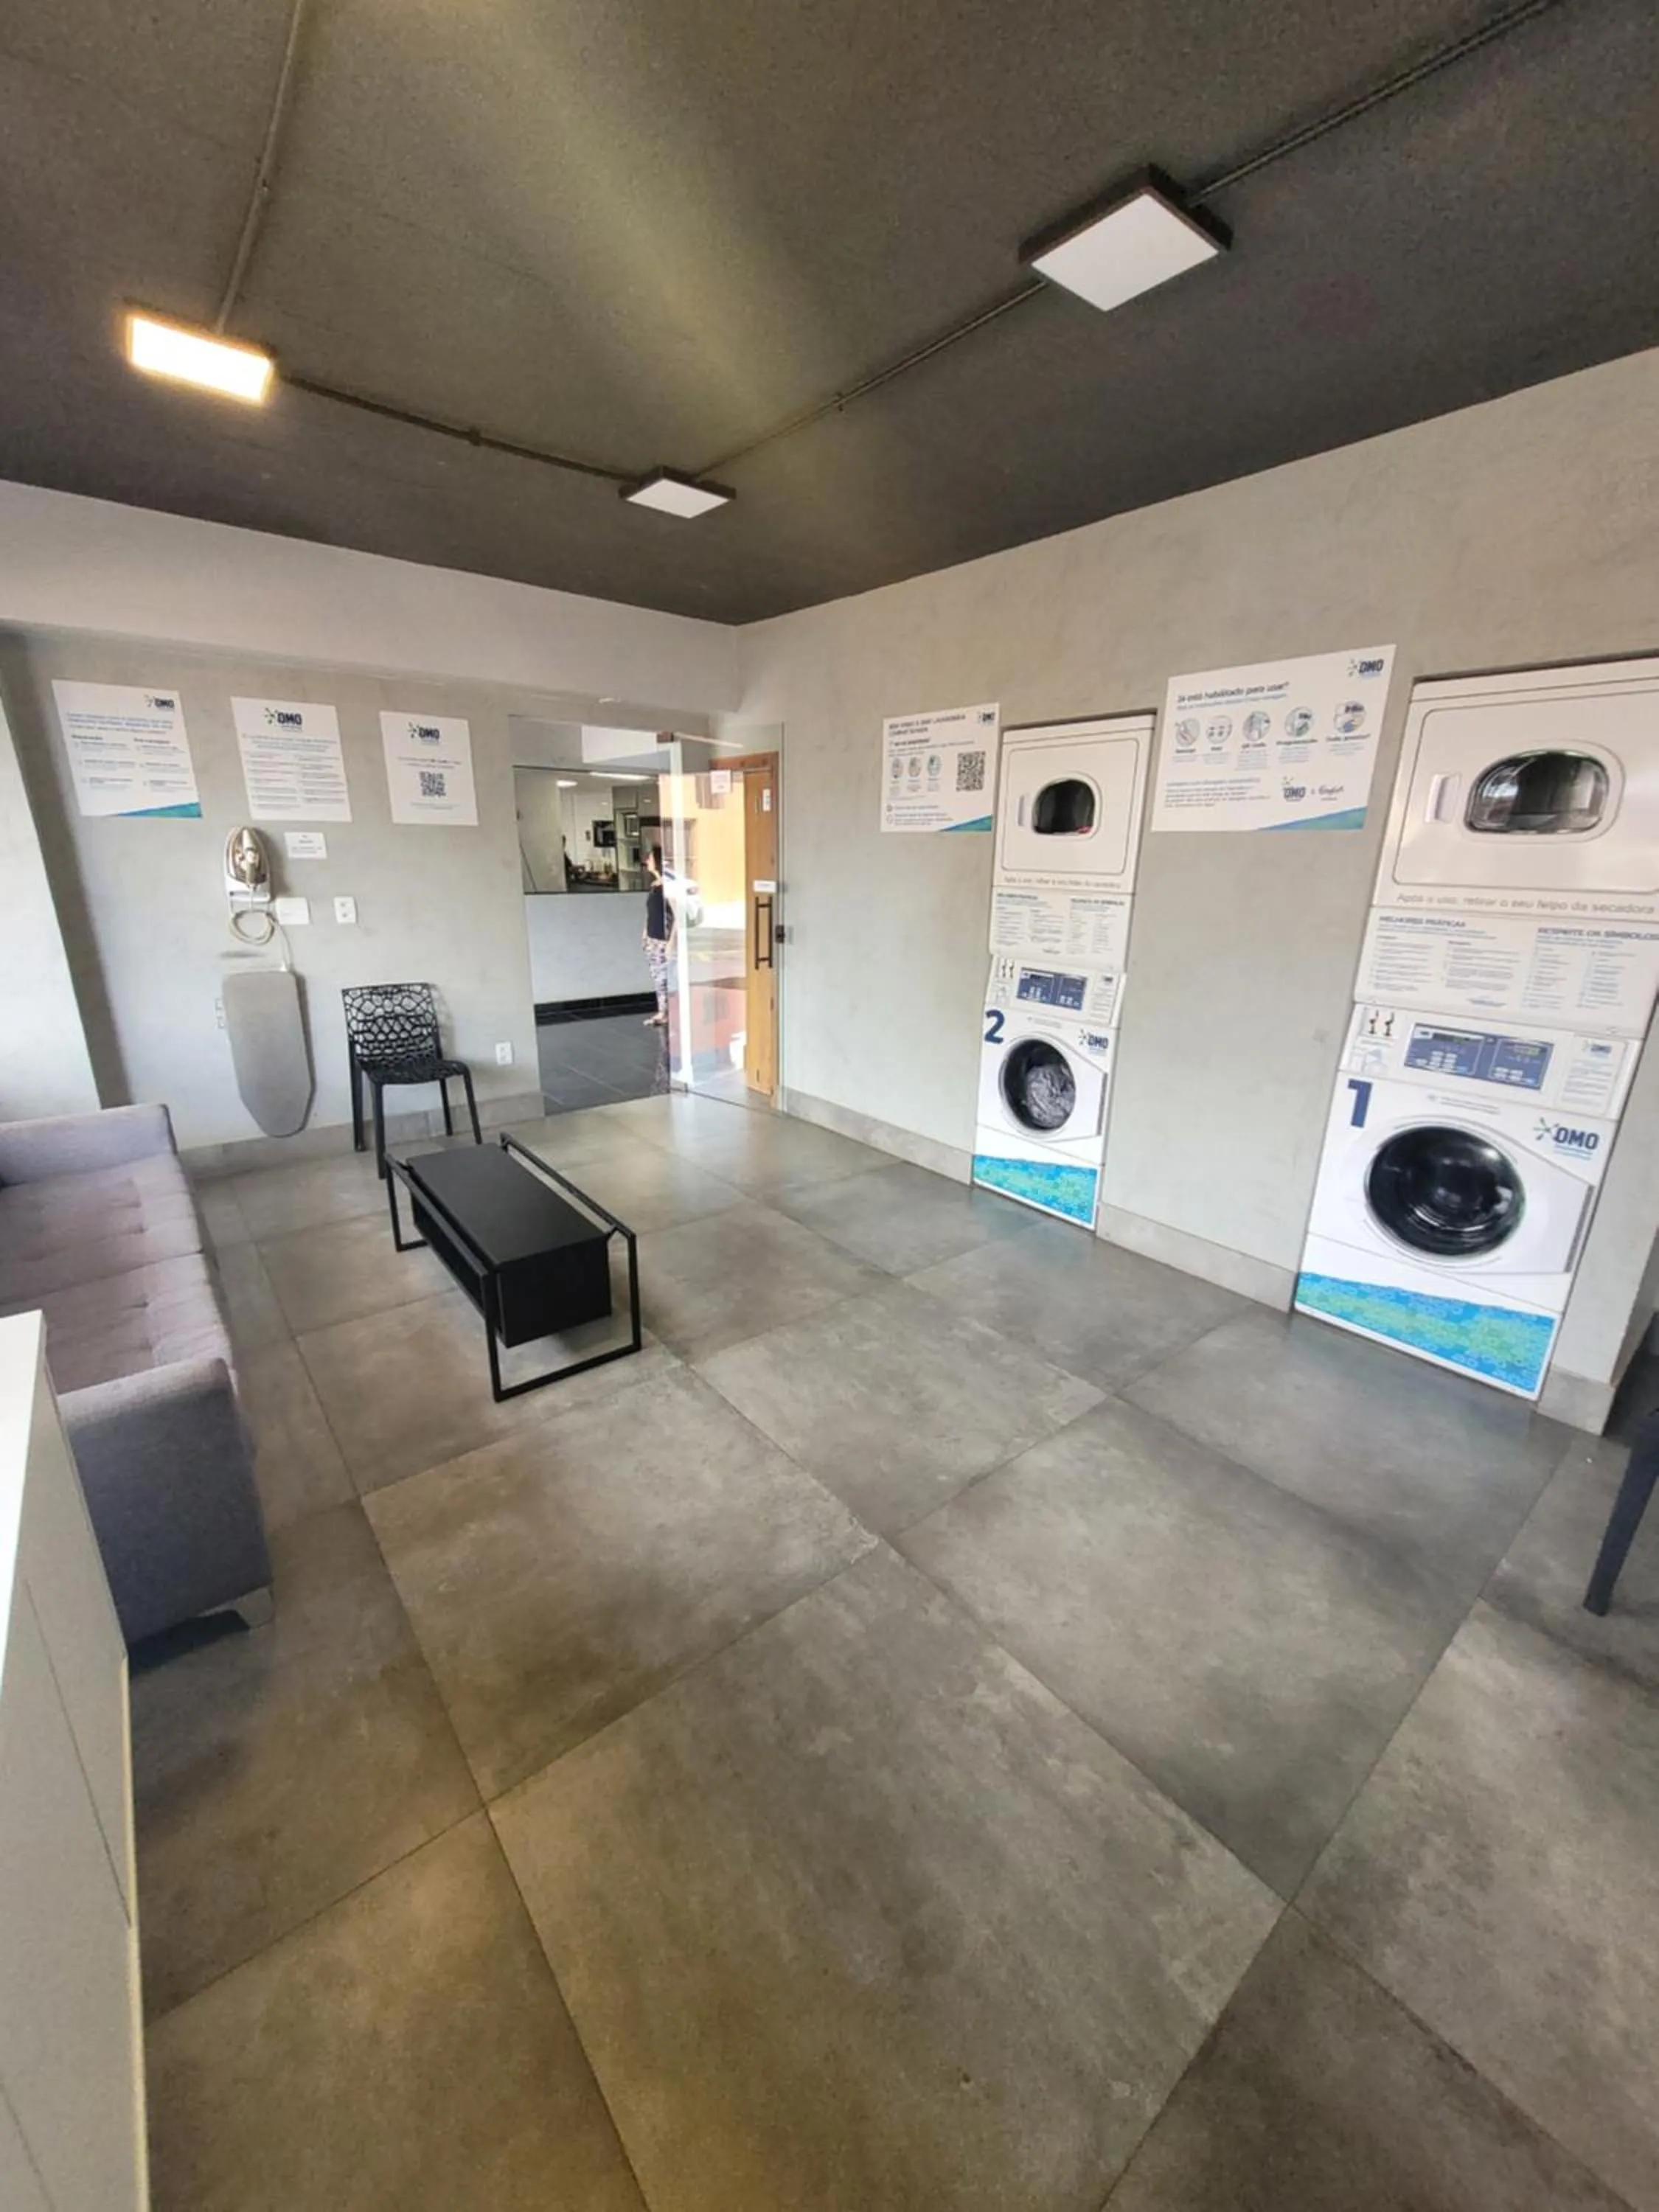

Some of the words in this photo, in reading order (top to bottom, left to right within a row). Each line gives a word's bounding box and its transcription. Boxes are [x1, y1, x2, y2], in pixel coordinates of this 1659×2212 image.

[1359, 658, 1384, 672] OMO
[1204, 687, 1245, 699] habilitado
[1245, 686, 1265, 696] para
[155, 698, 175, 709] OMO
[277, 712, 302, 726] OMO
[419, 727, 440, 740] OMO
[1284, 786, 1306, 799] OMO
[1463, 897, 1497, 906] retirar
[1500, 899, 1509, 908] o
[1512, 900, 1534, 908] seu
[1571, 901, 1588, 911] da
[1592, 903, 1656, 914] secadora
[984, 1009, 1005, 1044] 2
[1088, 1032, 1109, 1049] OMO
[1348, 1078, 1373, 1128] 1
[1554, 1127, 1599, 1150] OMO
